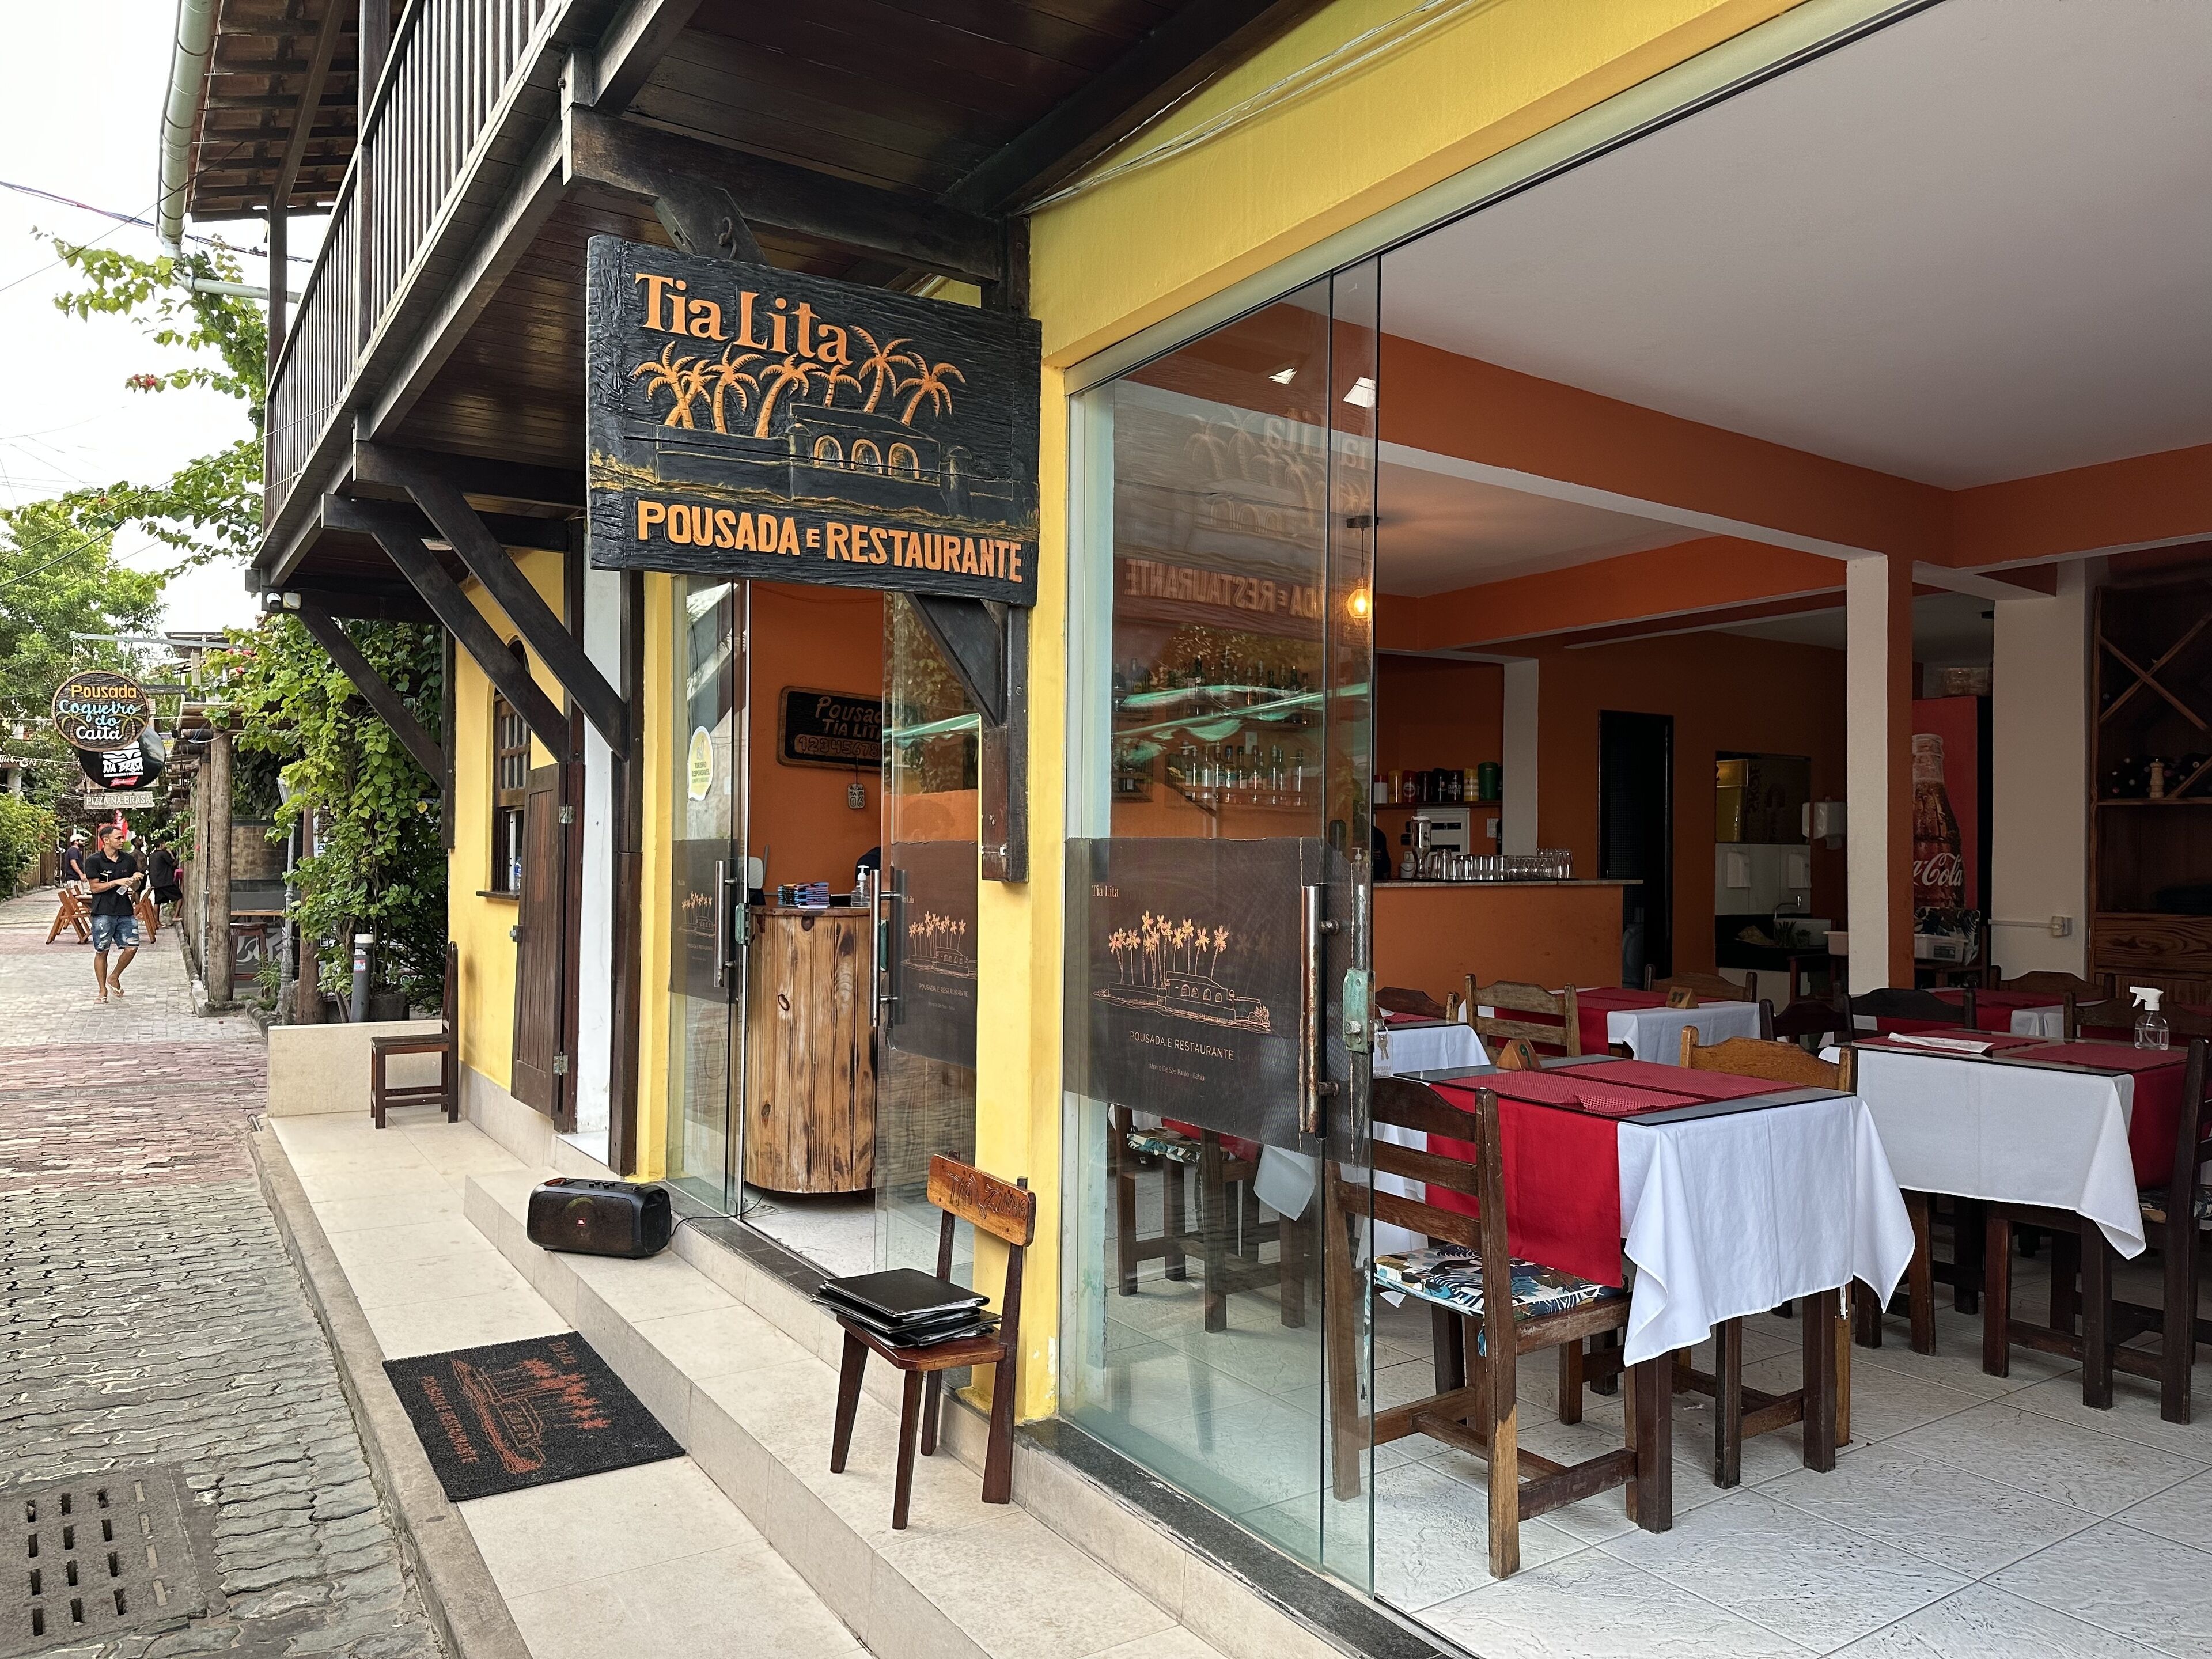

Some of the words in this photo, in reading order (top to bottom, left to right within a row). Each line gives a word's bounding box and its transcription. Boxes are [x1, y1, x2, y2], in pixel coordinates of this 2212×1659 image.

[635, 272, 729, 342] Tia
[733, 290, 854, 367] Lita
[637, 499, 800, 556] POUSADA
[806, 528, 820, 548] E
[826, 521, 1023, 583] RESTAURANTE
[70, 684, 137, 699] Pousada
[59, 699, 141, 723] Coqueiro
[95, 714, 121, 726] do
[815, 696, 882, 724] Pousa
[798, 736, 879, 757] 12345678
[103, 760, 116, 774] NA
[117, 757, 144, 774] BRASA
[86, 796, 108, 806] PIZZA
[111, 796, 122, 805] NA
[124, 794, 151, 804] BRASA
[1912, 852, 1963, 887] a-Cola
[1092, 884, 1103, 897] Tia
[1105, 885, 1119, 897] Lita
[918, 982, 937, 993] POUSADA
[940, 986, 968, 998] RESTAURANTE
[1129, 1031, 1166, 1047] POUSADA
[1168, 1037, 1173, 1048] E
[1175, 1039, 1234, 1061] RESTAURANTE
